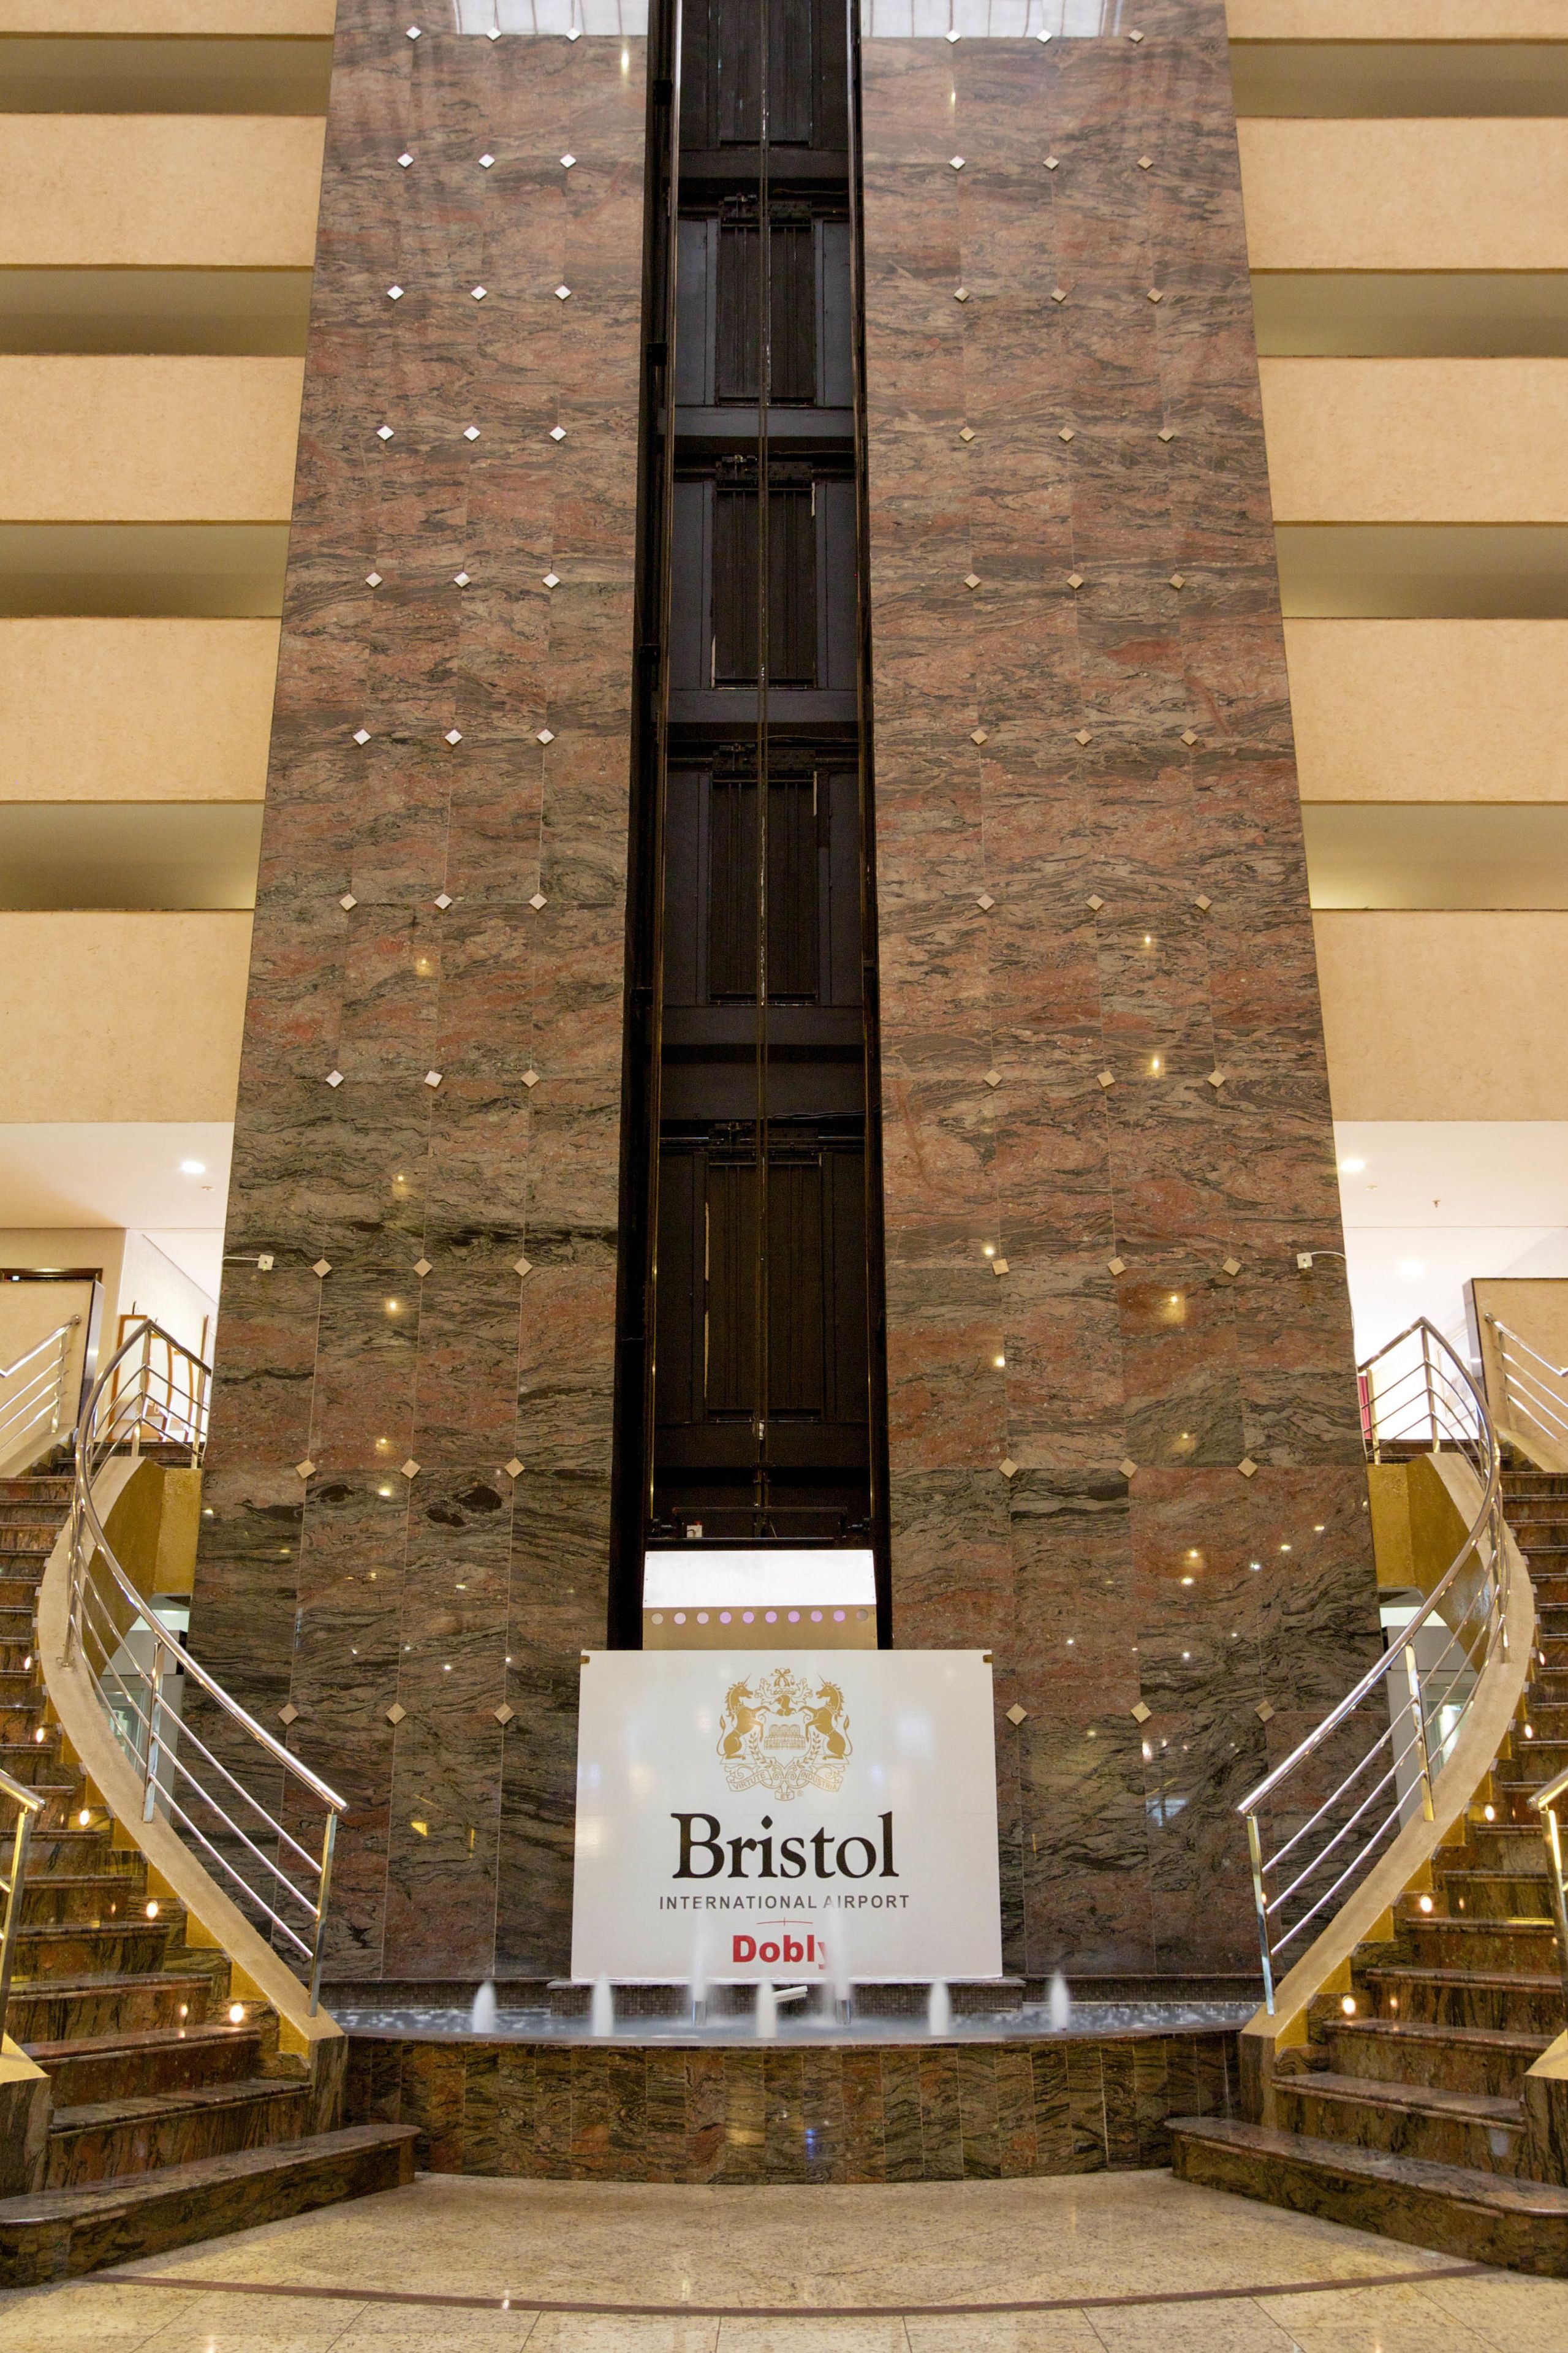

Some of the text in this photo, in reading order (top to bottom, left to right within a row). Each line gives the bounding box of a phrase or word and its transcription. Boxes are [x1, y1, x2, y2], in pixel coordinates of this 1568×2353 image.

[732, 1772, 765, 1790] VIRTUTE
[800, 1771, 839, 1790] INDUSTRIA
[670, 1811, 900, 1879] Bristol
[660, 1895, 909, 1910] INTERNATIONAL AIRPORT
